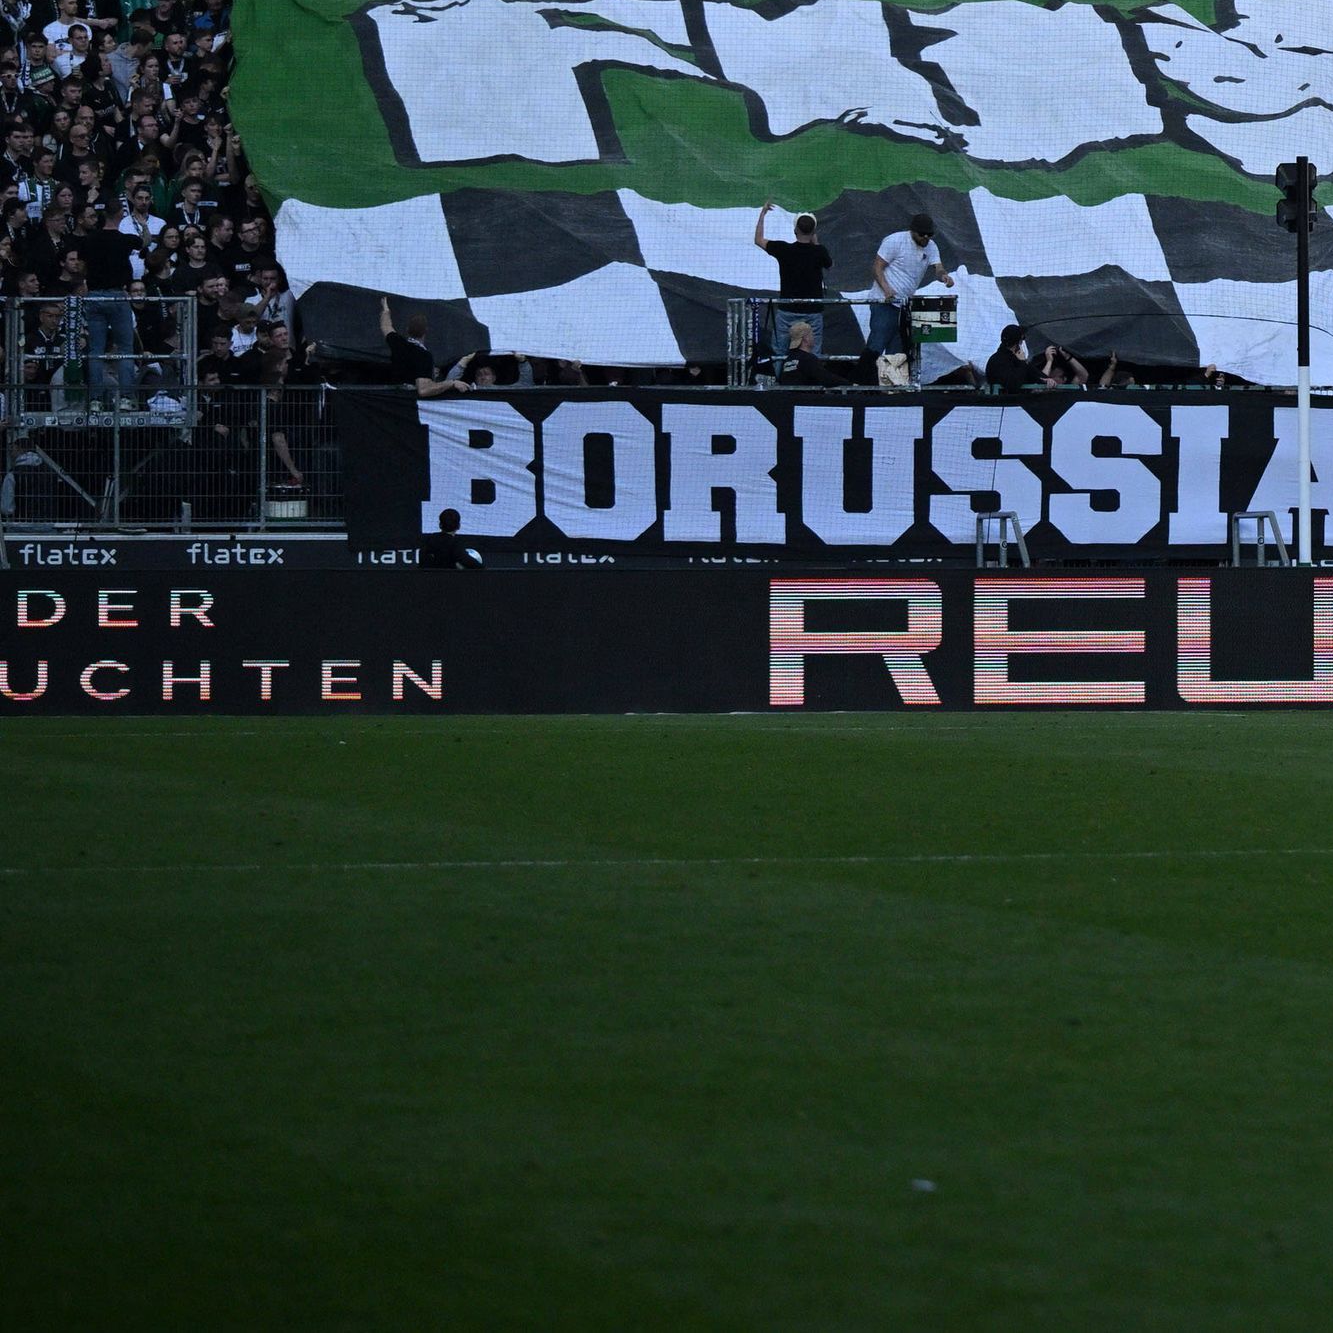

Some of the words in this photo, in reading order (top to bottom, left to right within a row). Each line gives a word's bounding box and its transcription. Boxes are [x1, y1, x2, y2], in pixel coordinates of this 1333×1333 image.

[20, 543, 117, 565] flatex
[187, 543, 285, 565] flatex
[16, 589, 215, 628] DER
